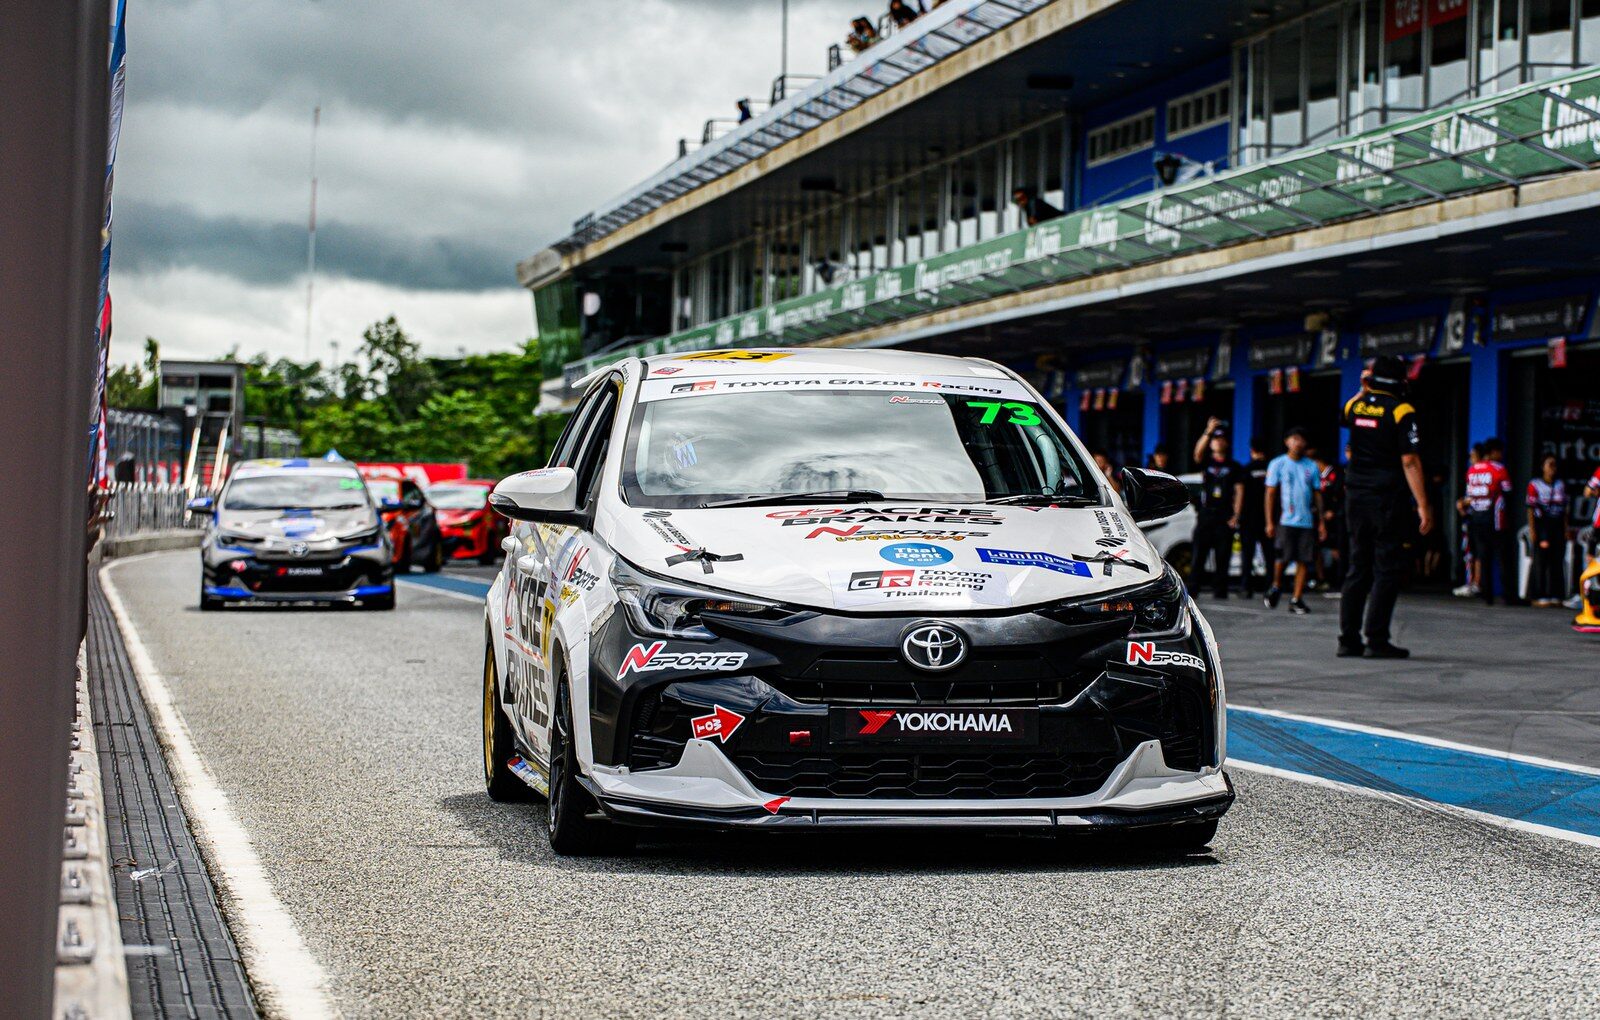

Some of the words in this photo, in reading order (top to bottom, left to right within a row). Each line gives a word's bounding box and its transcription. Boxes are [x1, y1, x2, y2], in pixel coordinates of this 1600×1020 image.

[722, 380, 820, 388] TOYOTA
[922, 381, 1002, 394] Racing
[966, 401, 1041, 426] 73
[839, 507, 998, 516] ACRE
[781, 516, 1003, 526] BRAKES
[990, 558, 1077, 574] DIGITAL
[920, 570, 993, 579] TOYOTA
[920, 575, 986, 583] GAZOO
[850, 572, 914, 590] GR
[918, 581, 984, 591] Racing
[883, 590, 961, 598] Thailand
[697, 719, 722, 733] TOW
[896, 712, 1012, 732] YOKOHAMA
